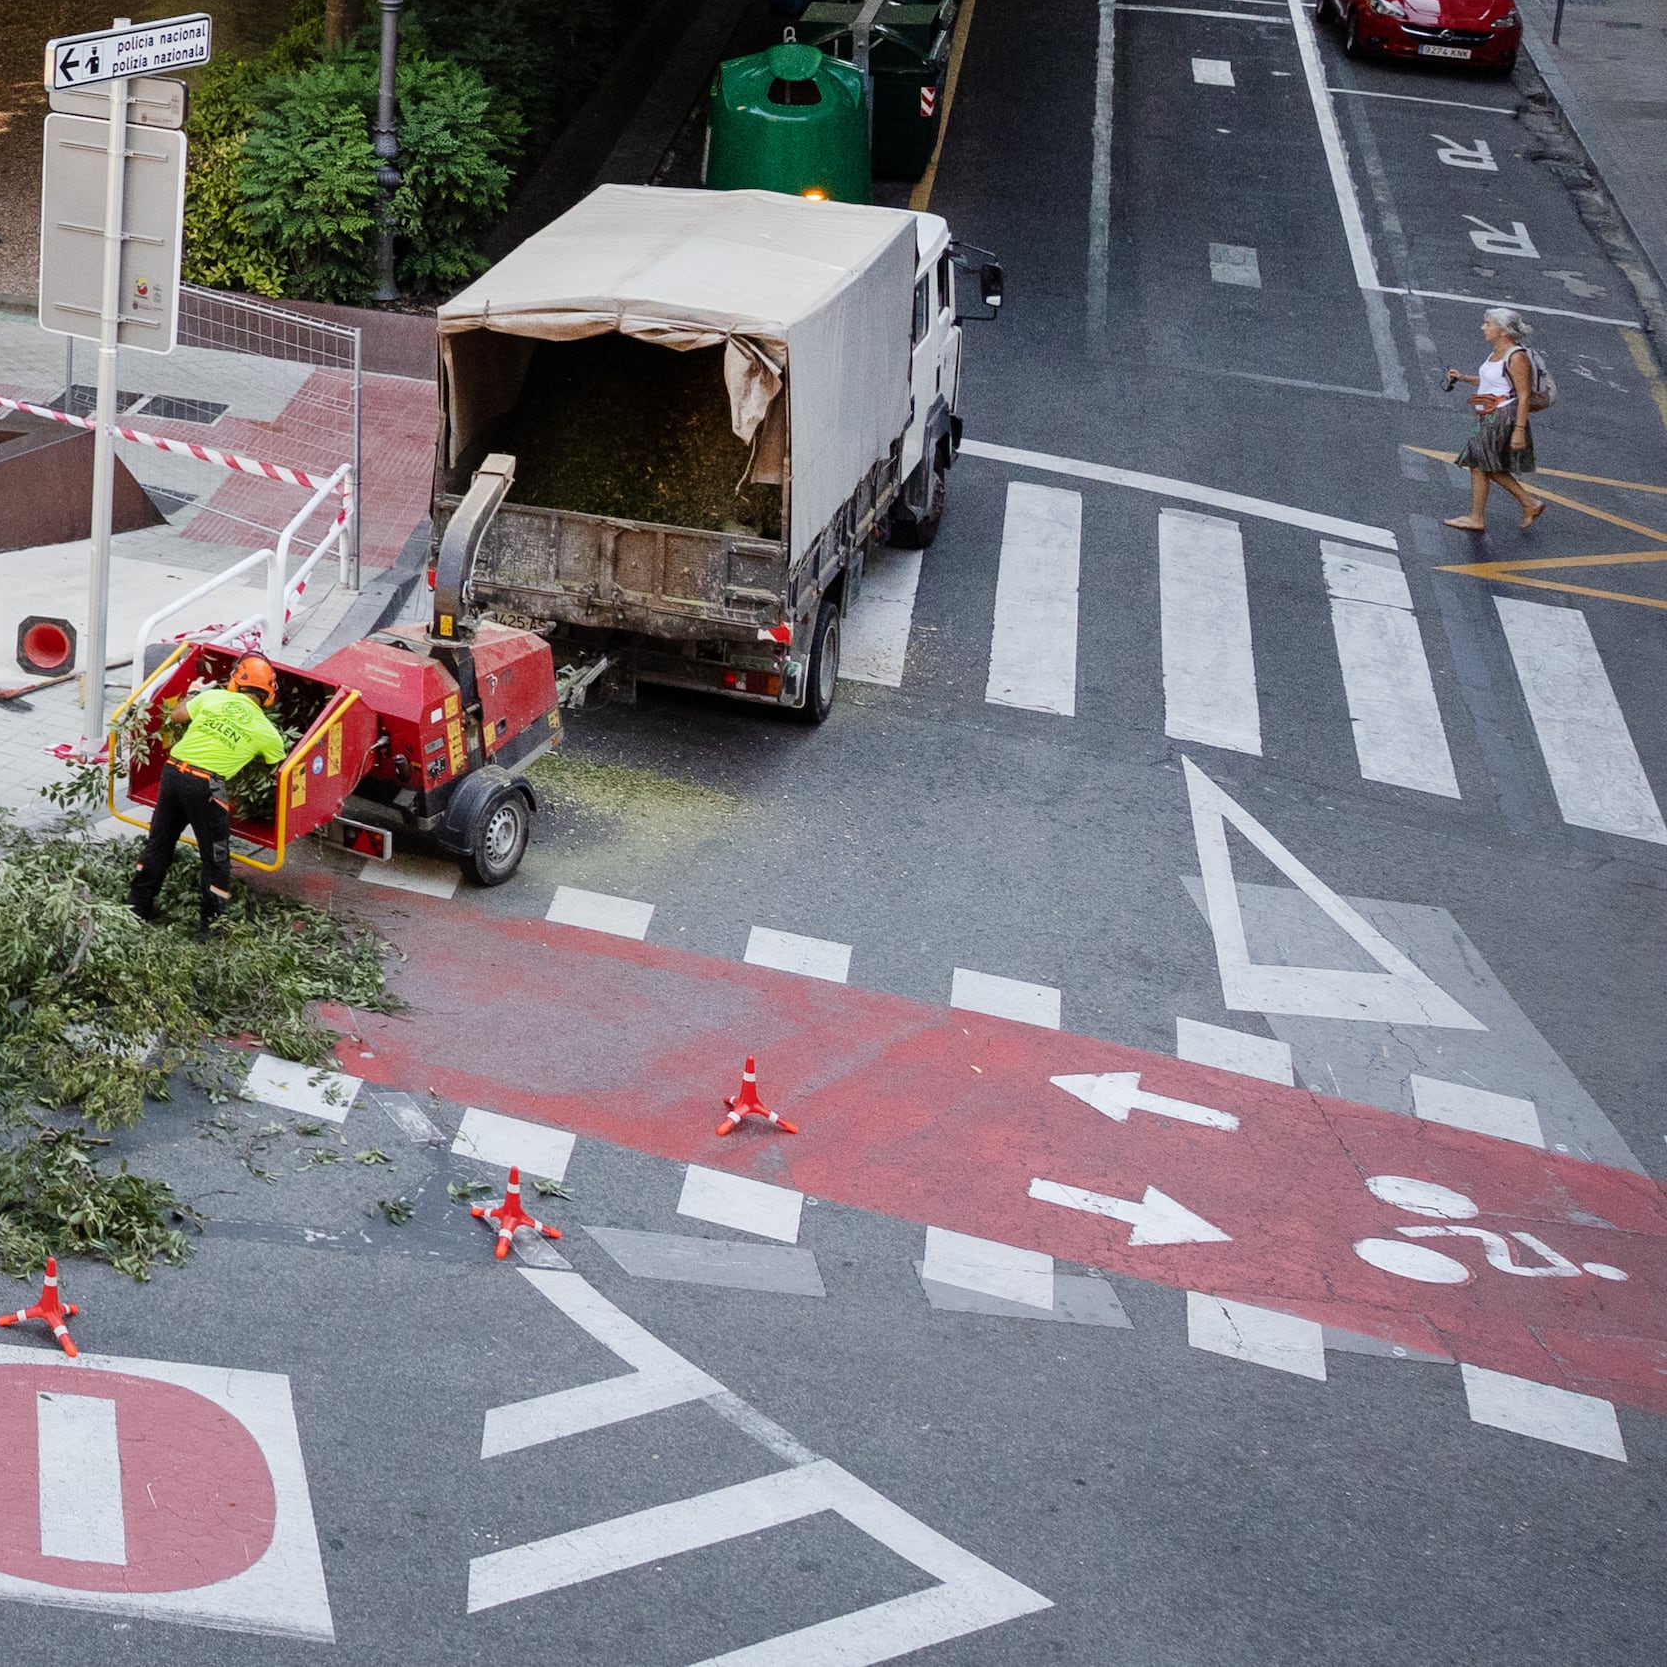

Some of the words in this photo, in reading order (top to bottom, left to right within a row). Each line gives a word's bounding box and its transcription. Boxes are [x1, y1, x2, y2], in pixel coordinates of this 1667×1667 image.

[160, 23, 206, 45] nacional
[112, 54, 148, 77] polizia
[154, 44, 205, 66] nazionala
